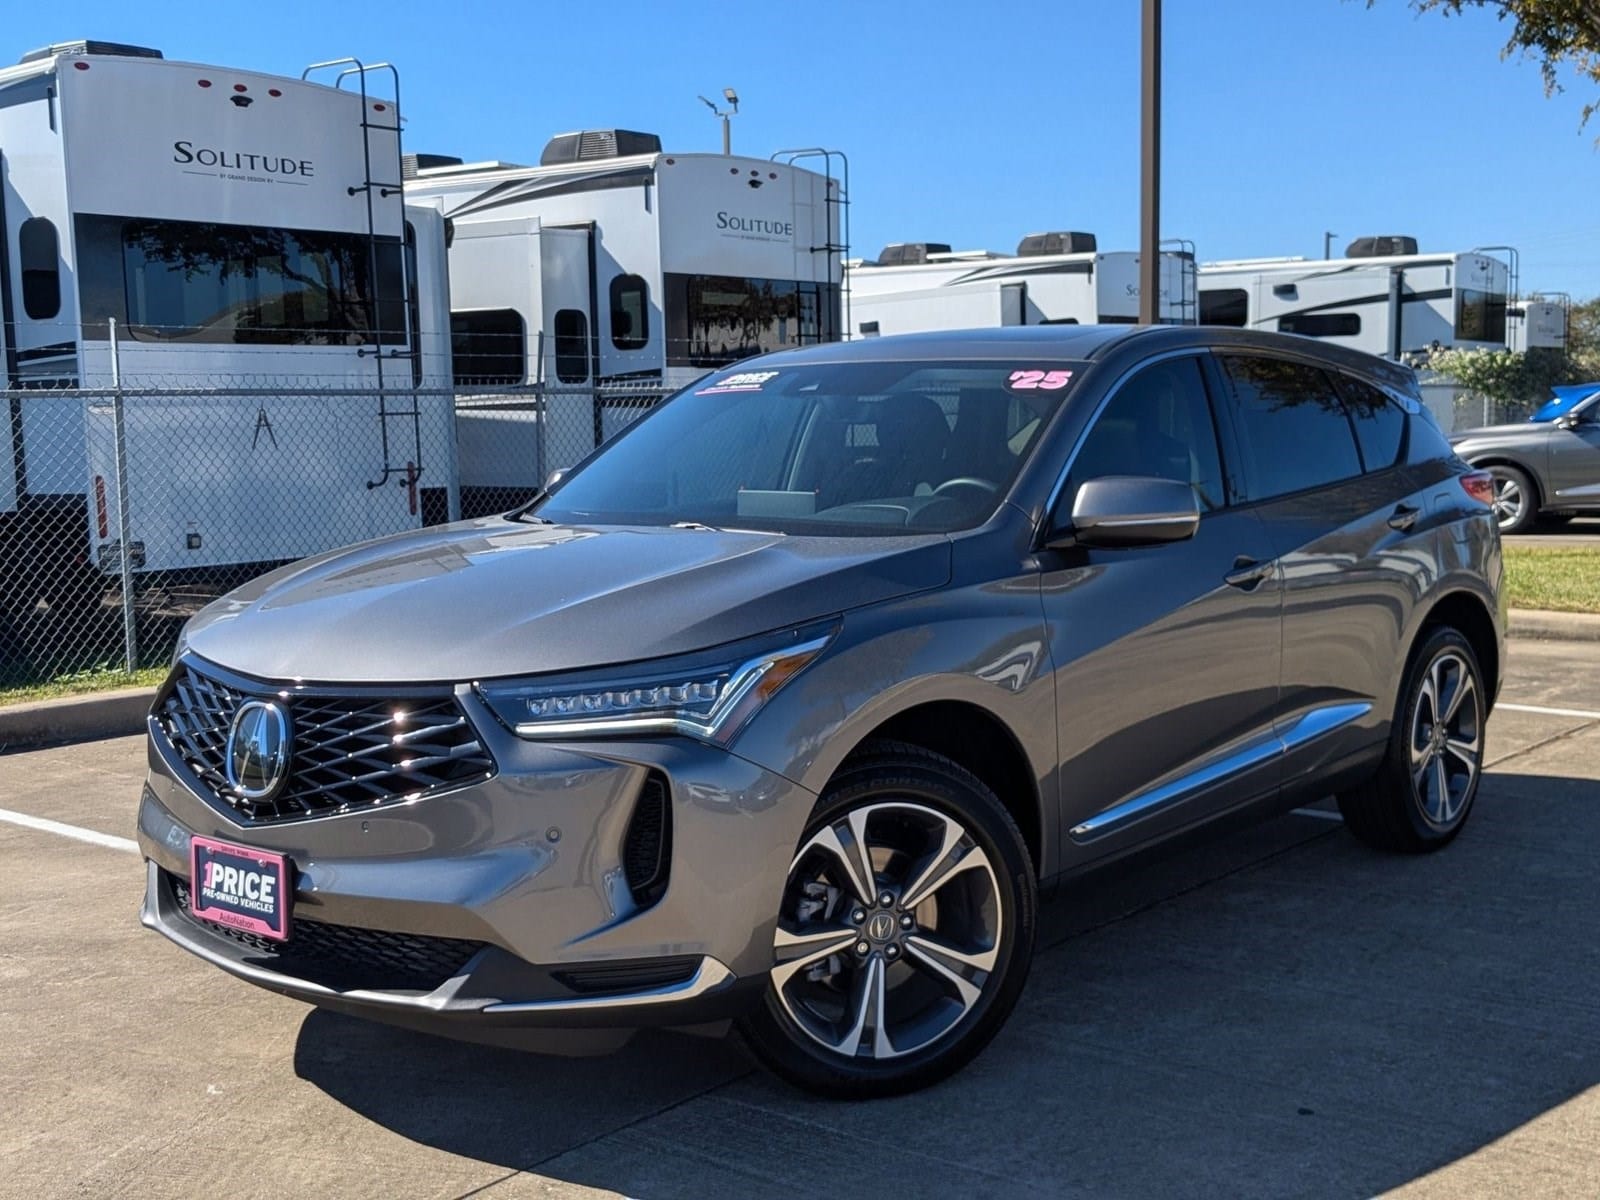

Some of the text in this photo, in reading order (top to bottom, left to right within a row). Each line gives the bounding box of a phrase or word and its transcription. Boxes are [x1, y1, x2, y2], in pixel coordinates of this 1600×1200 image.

[173, 141, 314, 177] SOLITUDE
[716, 211, 793, 236] SOLITUDE
[202, 887, 274, 914] PRE-OWNED VEHICLES
[219, 912, 255, 929] AutoNation
